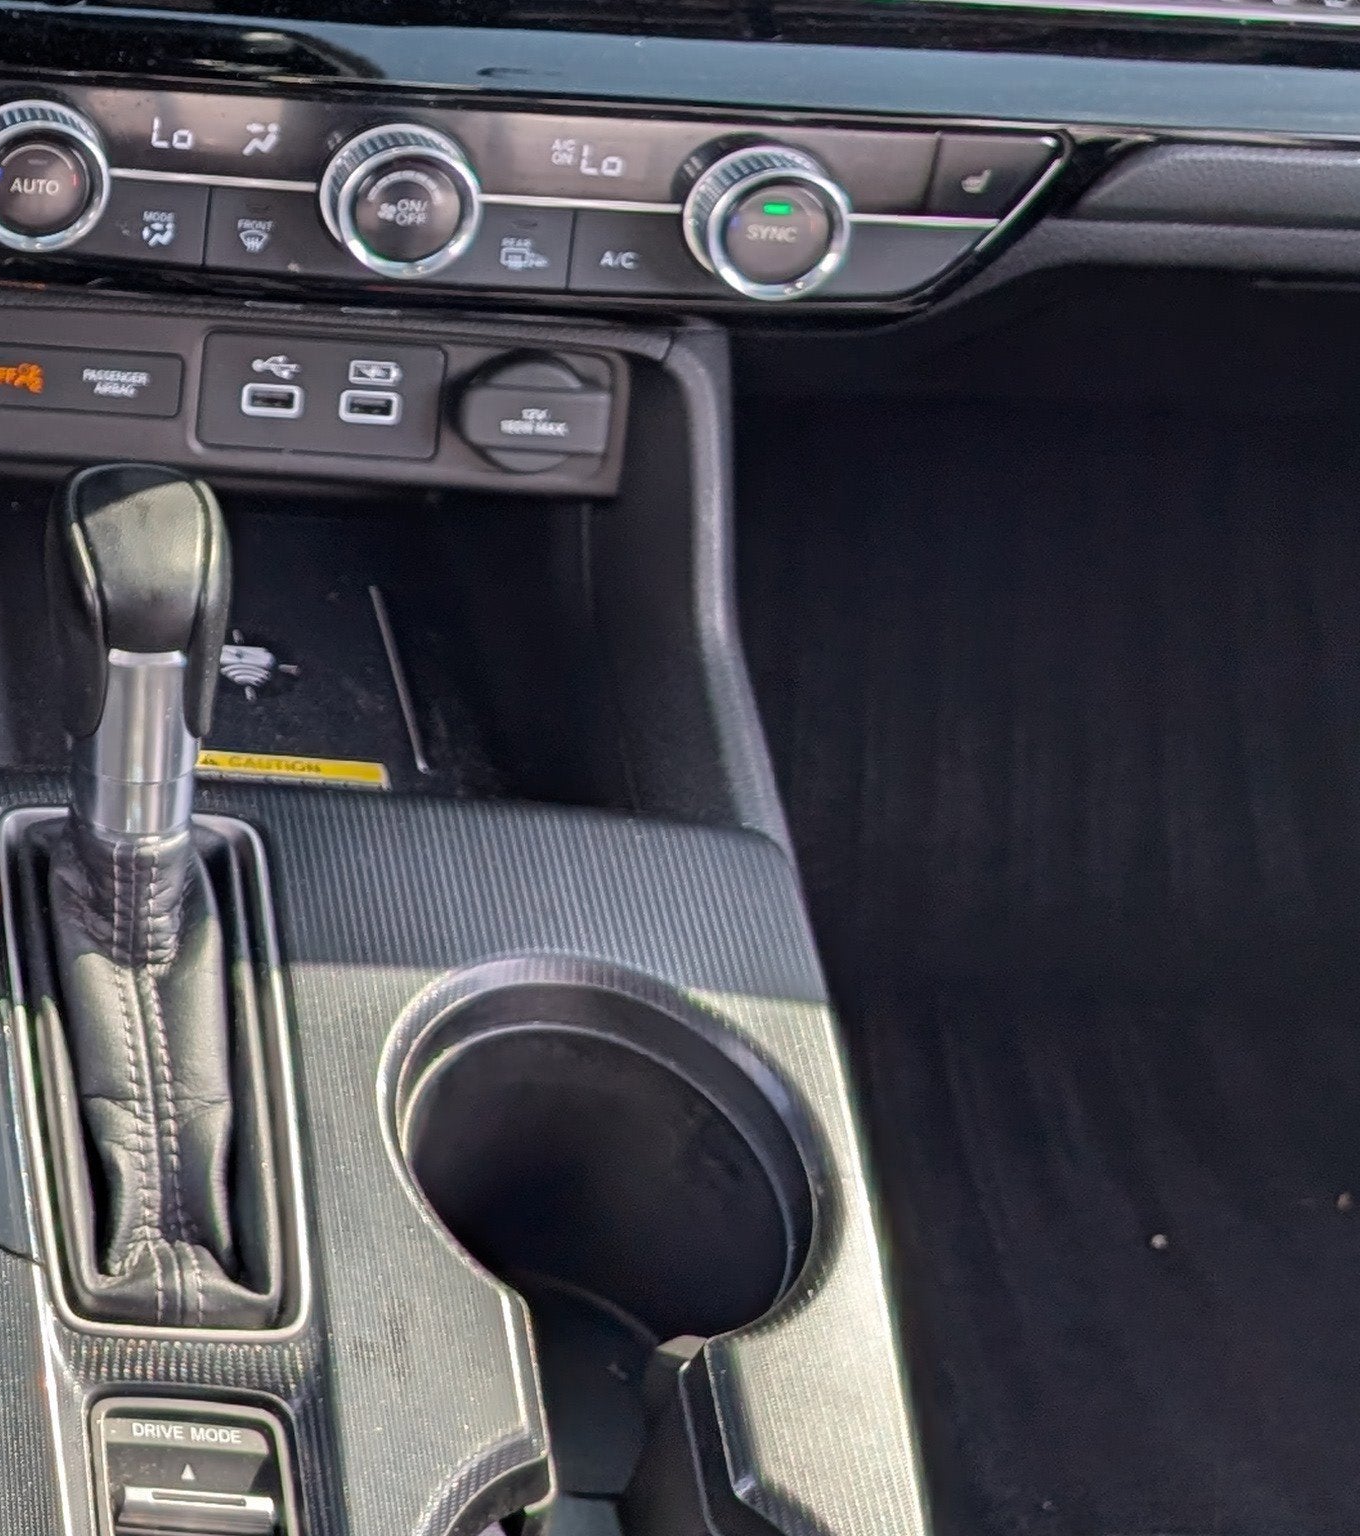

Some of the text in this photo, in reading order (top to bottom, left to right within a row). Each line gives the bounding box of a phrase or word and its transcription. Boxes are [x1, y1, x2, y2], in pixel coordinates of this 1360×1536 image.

[9, 177, 60, 196] AUTO
[394, 210, 427, 226] OFF
[746, 222, 797, 243] SYNC
[599, 250, 639, 270] A/C
[230, 756, 321, 772] CAUTION
[132, 1422, 242, 1444] DRIVE MODE
